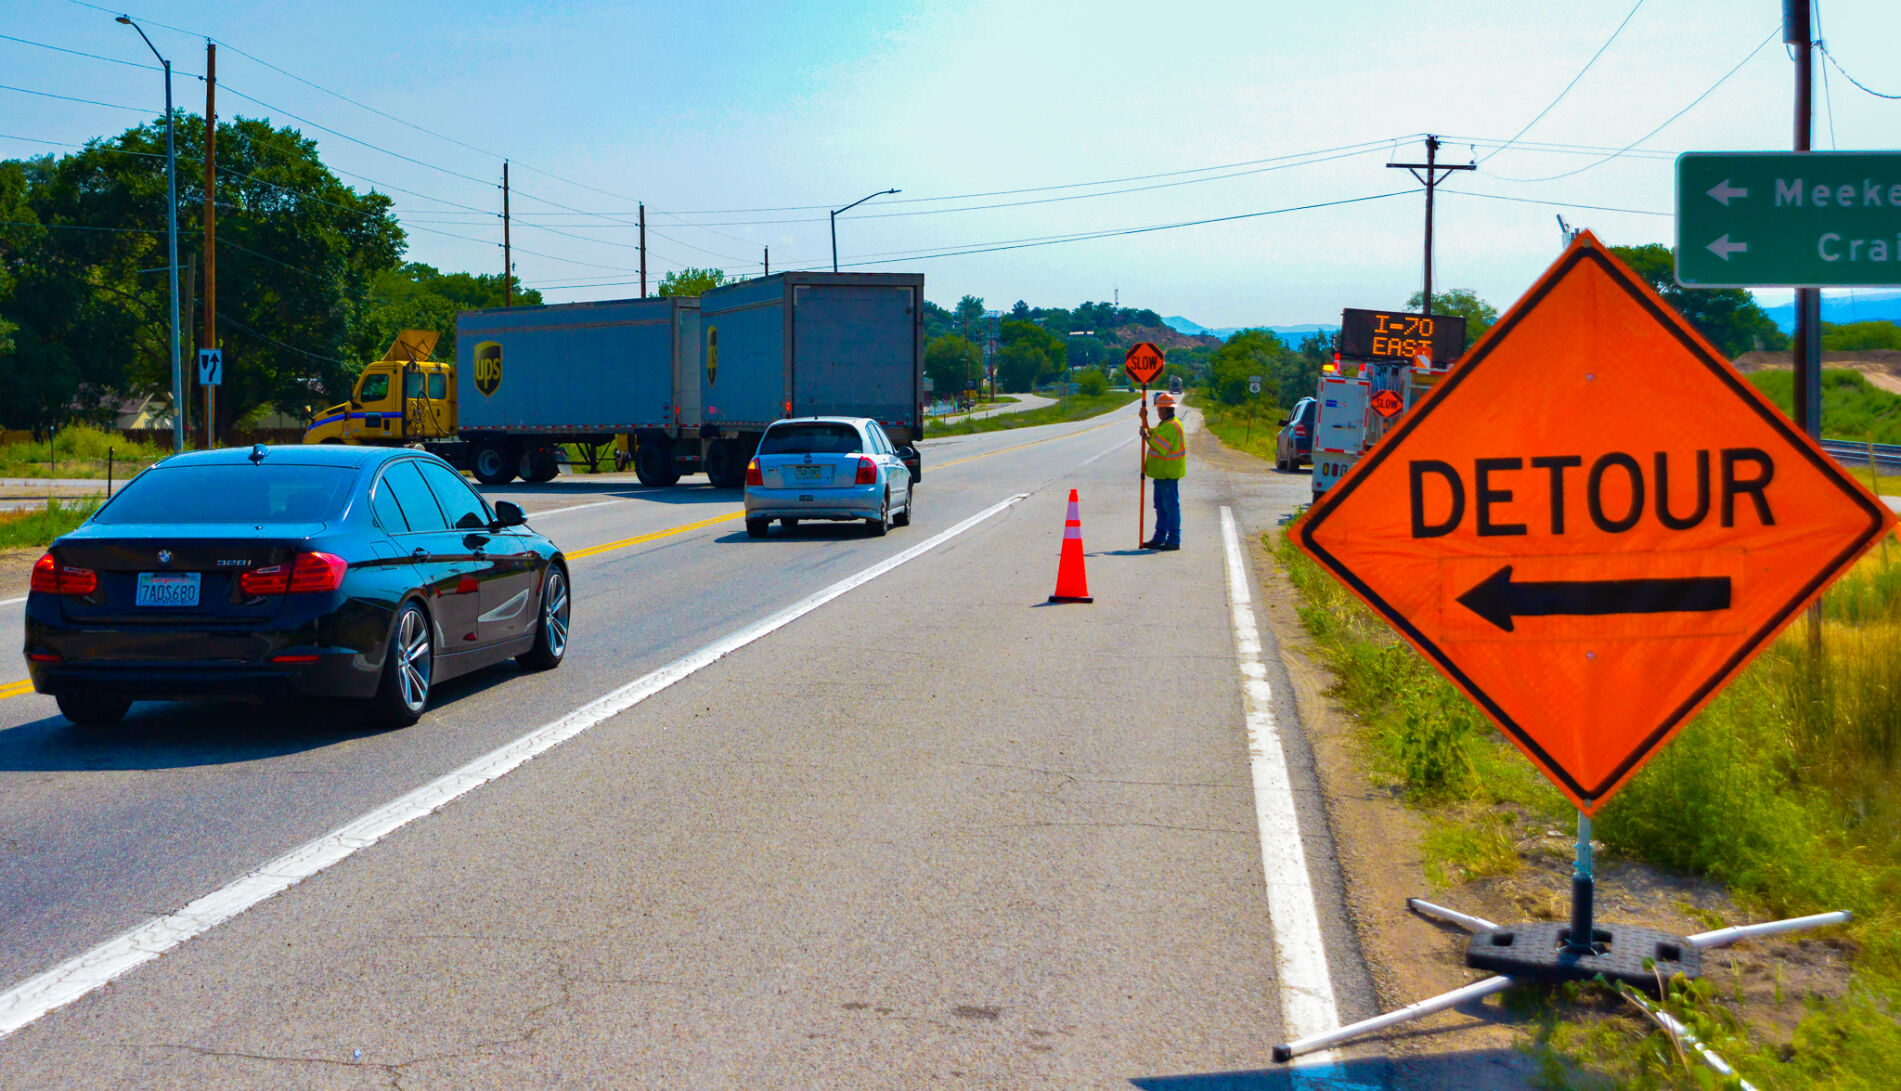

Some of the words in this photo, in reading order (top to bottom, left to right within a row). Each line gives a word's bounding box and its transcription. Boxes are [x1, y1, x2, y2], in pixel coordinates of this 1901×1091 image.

[1374, 314, 1434, 337] I-70
[475, 358, 500, 389] ups
[1131, 355, 1158, 370] SLOW
[1375, 398, 1398, 409] SLOW
[1409, 447, 1775, 539] DETOUR
